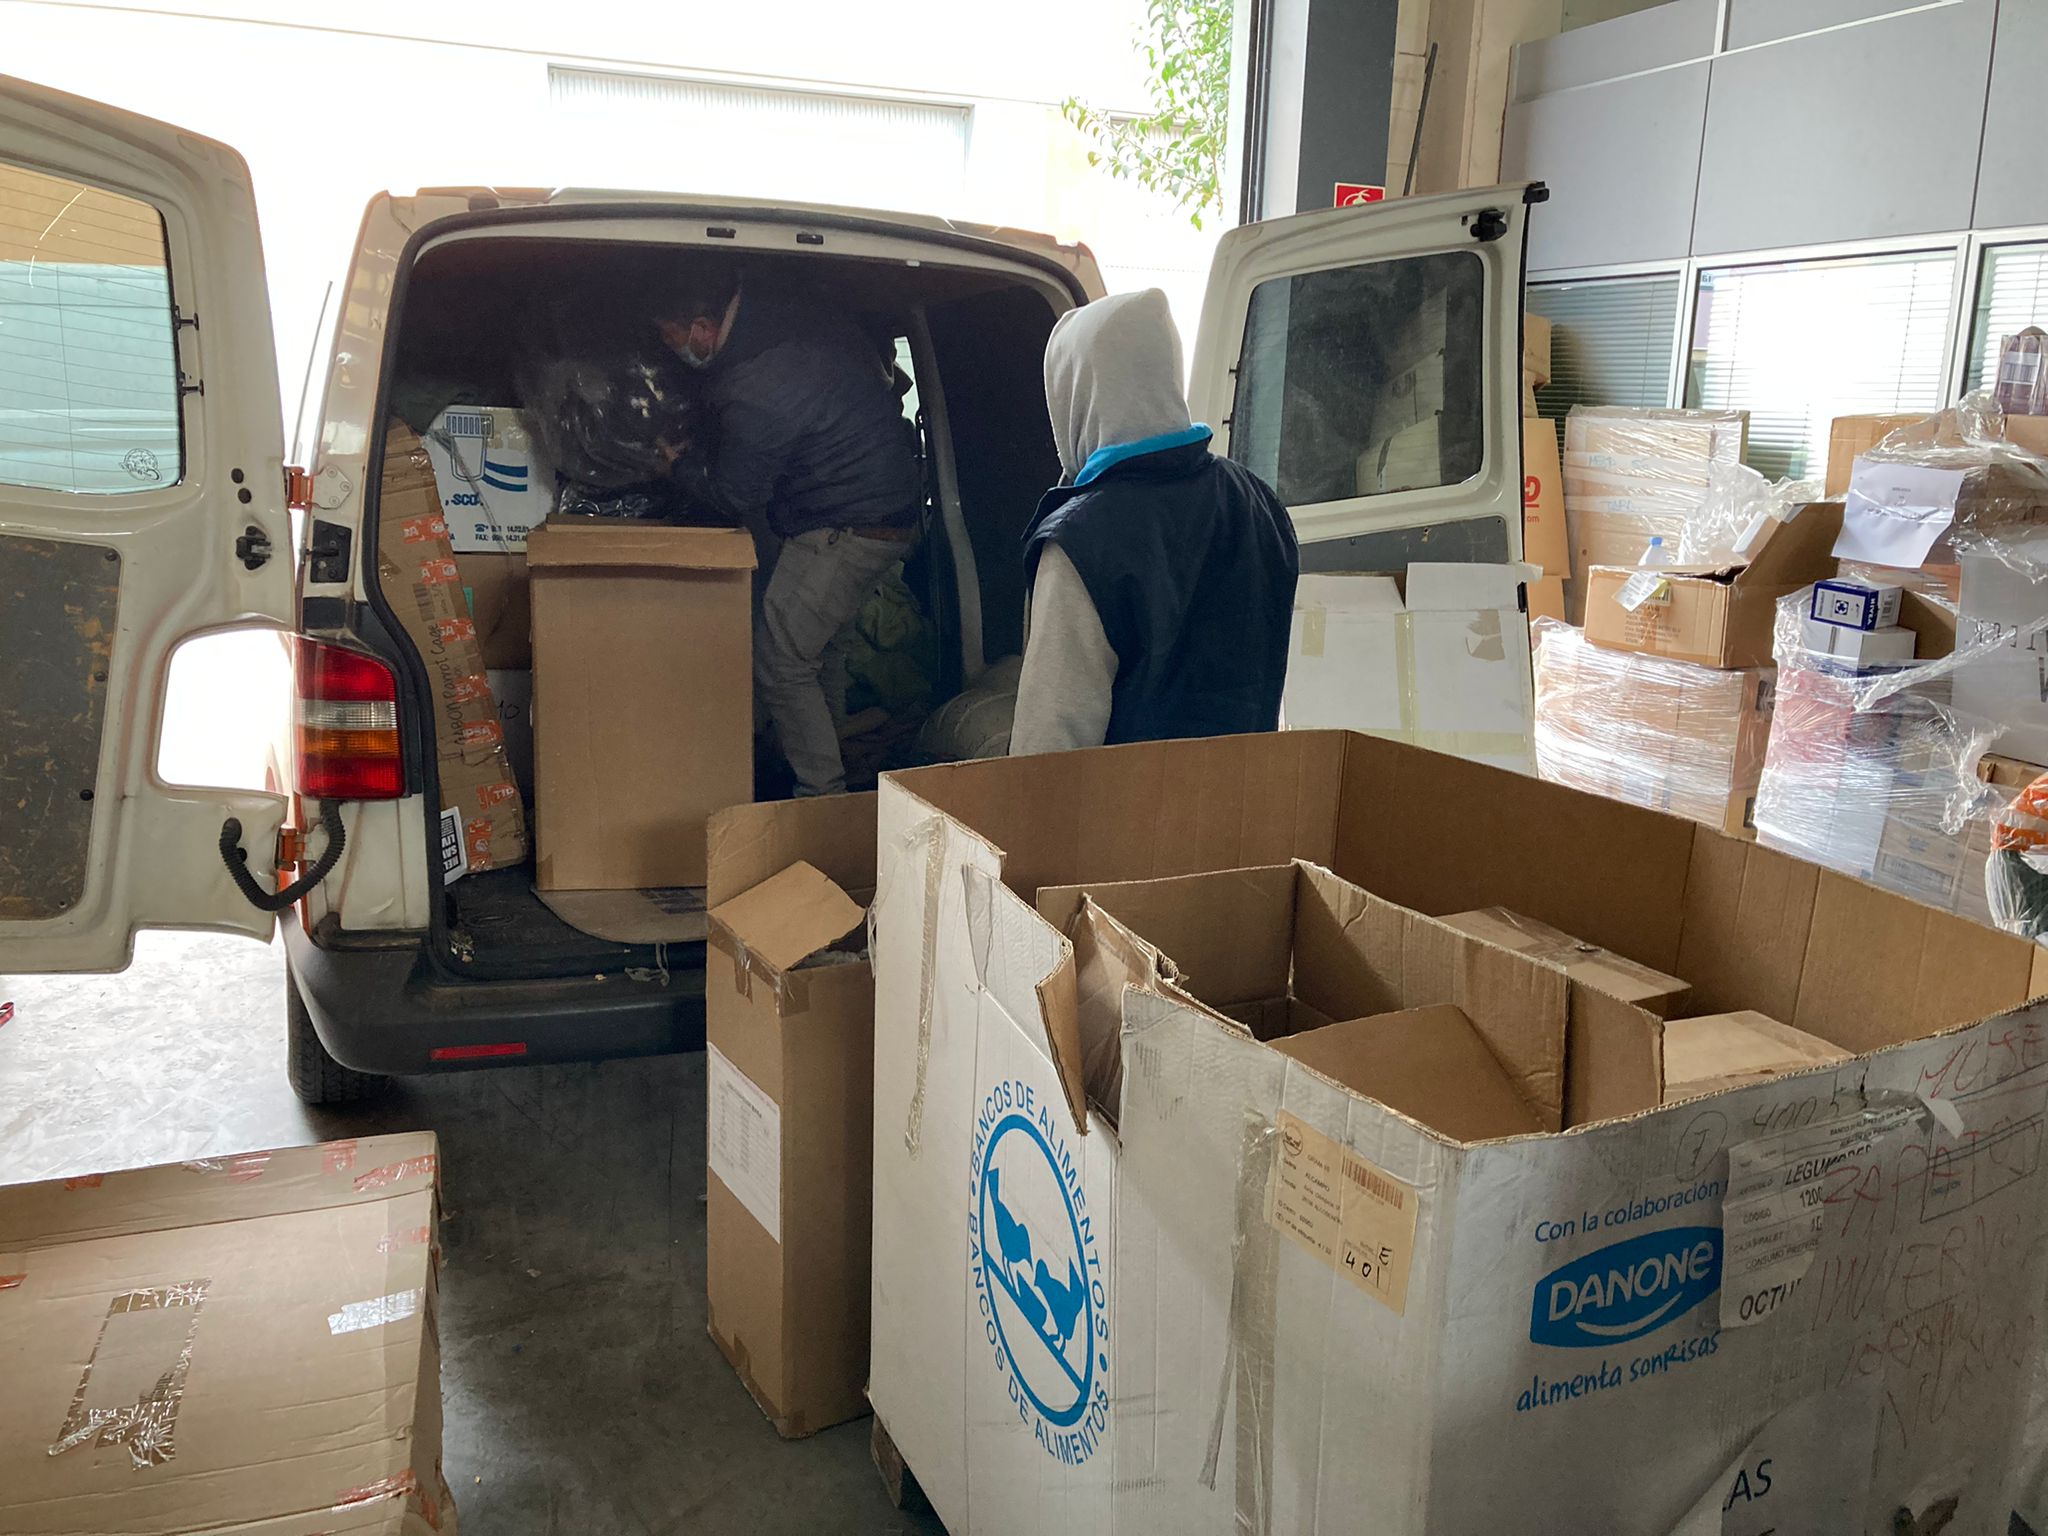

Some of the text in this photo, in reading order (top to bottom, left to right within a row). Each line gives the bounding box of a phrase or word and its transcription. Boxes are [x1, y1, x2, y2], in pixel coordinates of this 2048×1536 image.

[1867, 598, 1876, 625] NIVEA
[971, 1080, 1109, 1341] BANCOS DE ALIMENTOS
[1535, 1221, 1576, 1243] Con
[1582, 1211, 1599, 1233] la
[1604, 1180, 1720, 1227] colaboración
[1548, 1240, 1714, 1322] DANONE
[969, 1211, 1109, 1466] BANCOS DE ALIMENTOS
[1516, 1360, 1623, 1412] alimenta
